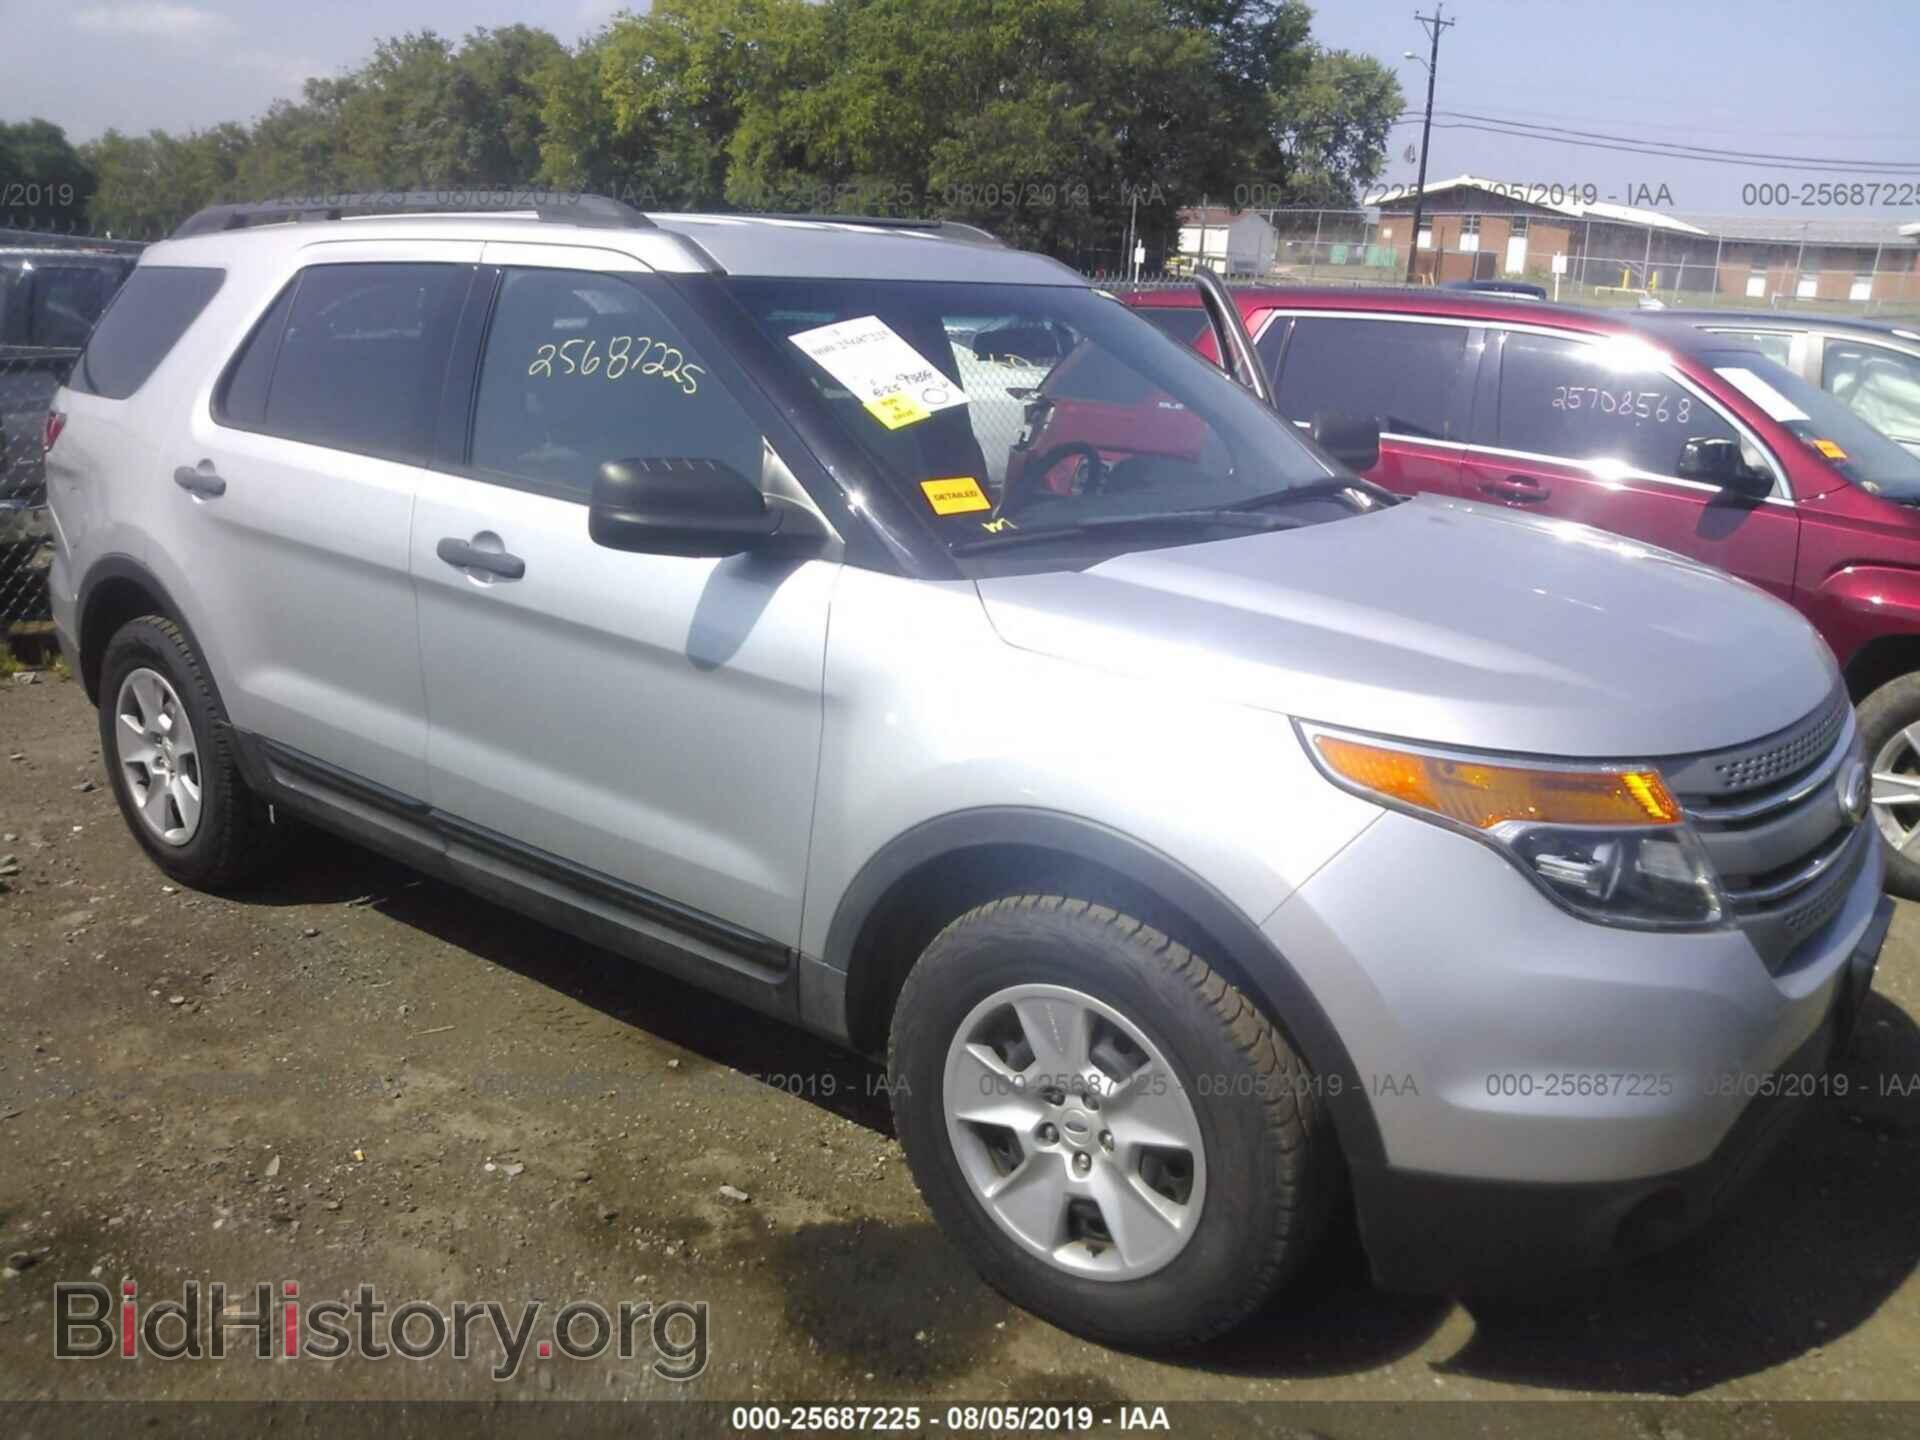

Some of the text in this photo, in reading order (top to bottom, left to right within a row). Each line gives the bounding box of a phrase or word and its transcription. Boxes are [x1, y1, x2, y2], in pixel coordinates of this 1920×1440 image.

[528, 336, 707, 395] 25687225
[1552, 386, 1692, 424] 25708568
[932, 490, 979, 502] DETAILED
